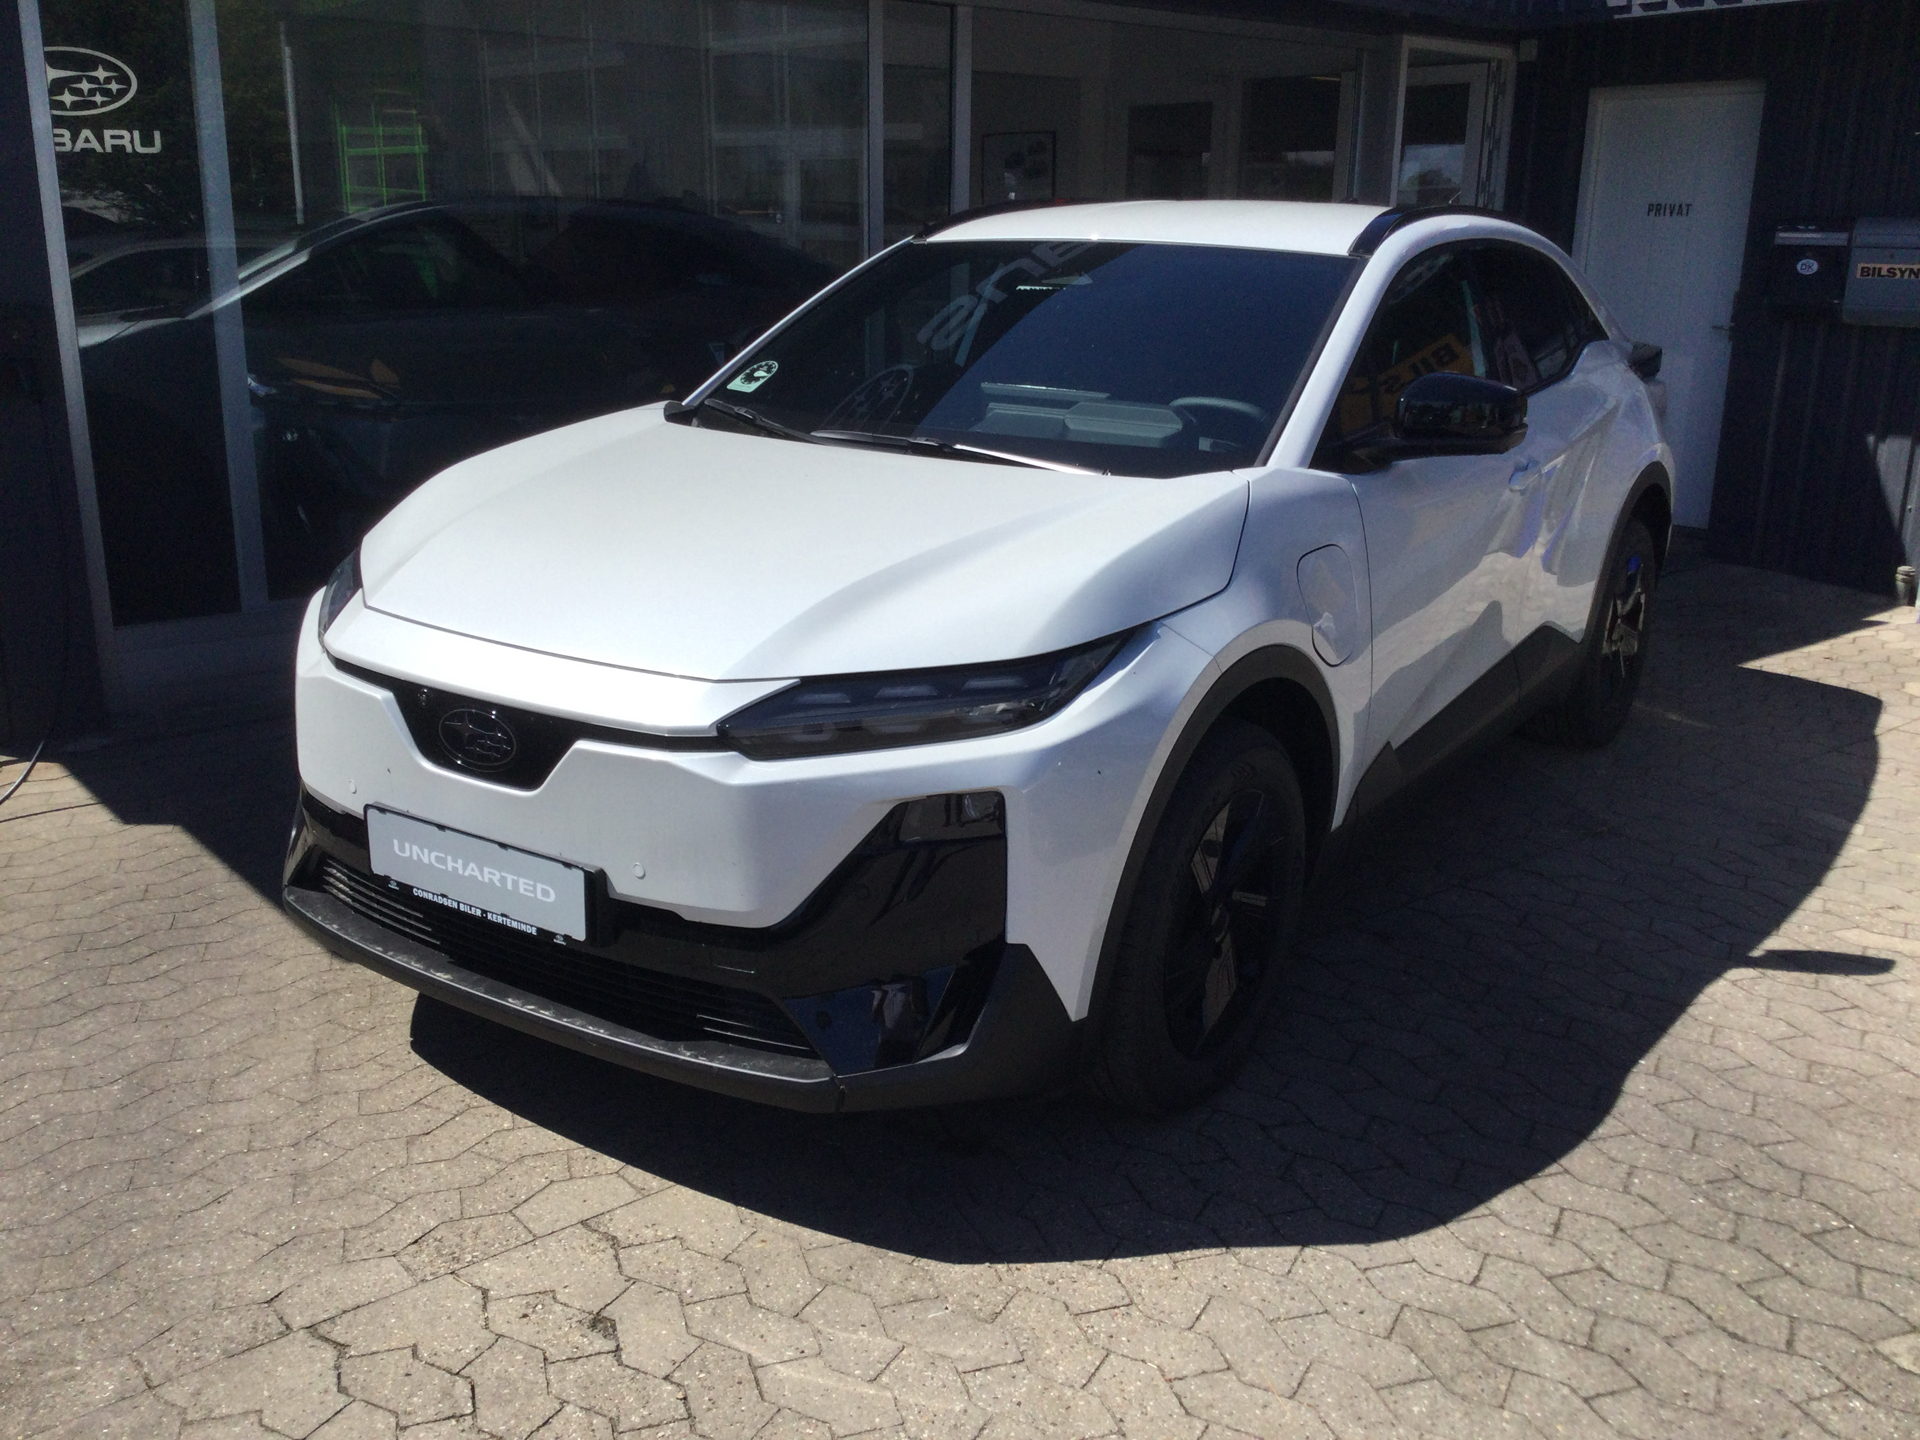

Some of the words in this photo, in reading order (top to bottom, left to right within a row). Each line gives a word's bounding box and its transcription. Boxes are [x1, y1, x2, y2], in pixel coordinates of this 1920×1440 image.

[53, 128, 162, 154] BARU
[1647, 203, 1692, 217] PRIVAT
[1860, 266, 1920, 279] BILSYN
[393, 839, 556, 903] UNCHARTED
[413, 887, 458, 910] CONRADSEN
[459, 902, 482, 917] BILER
[487, 912, 537, 935] KERTEMINDE
